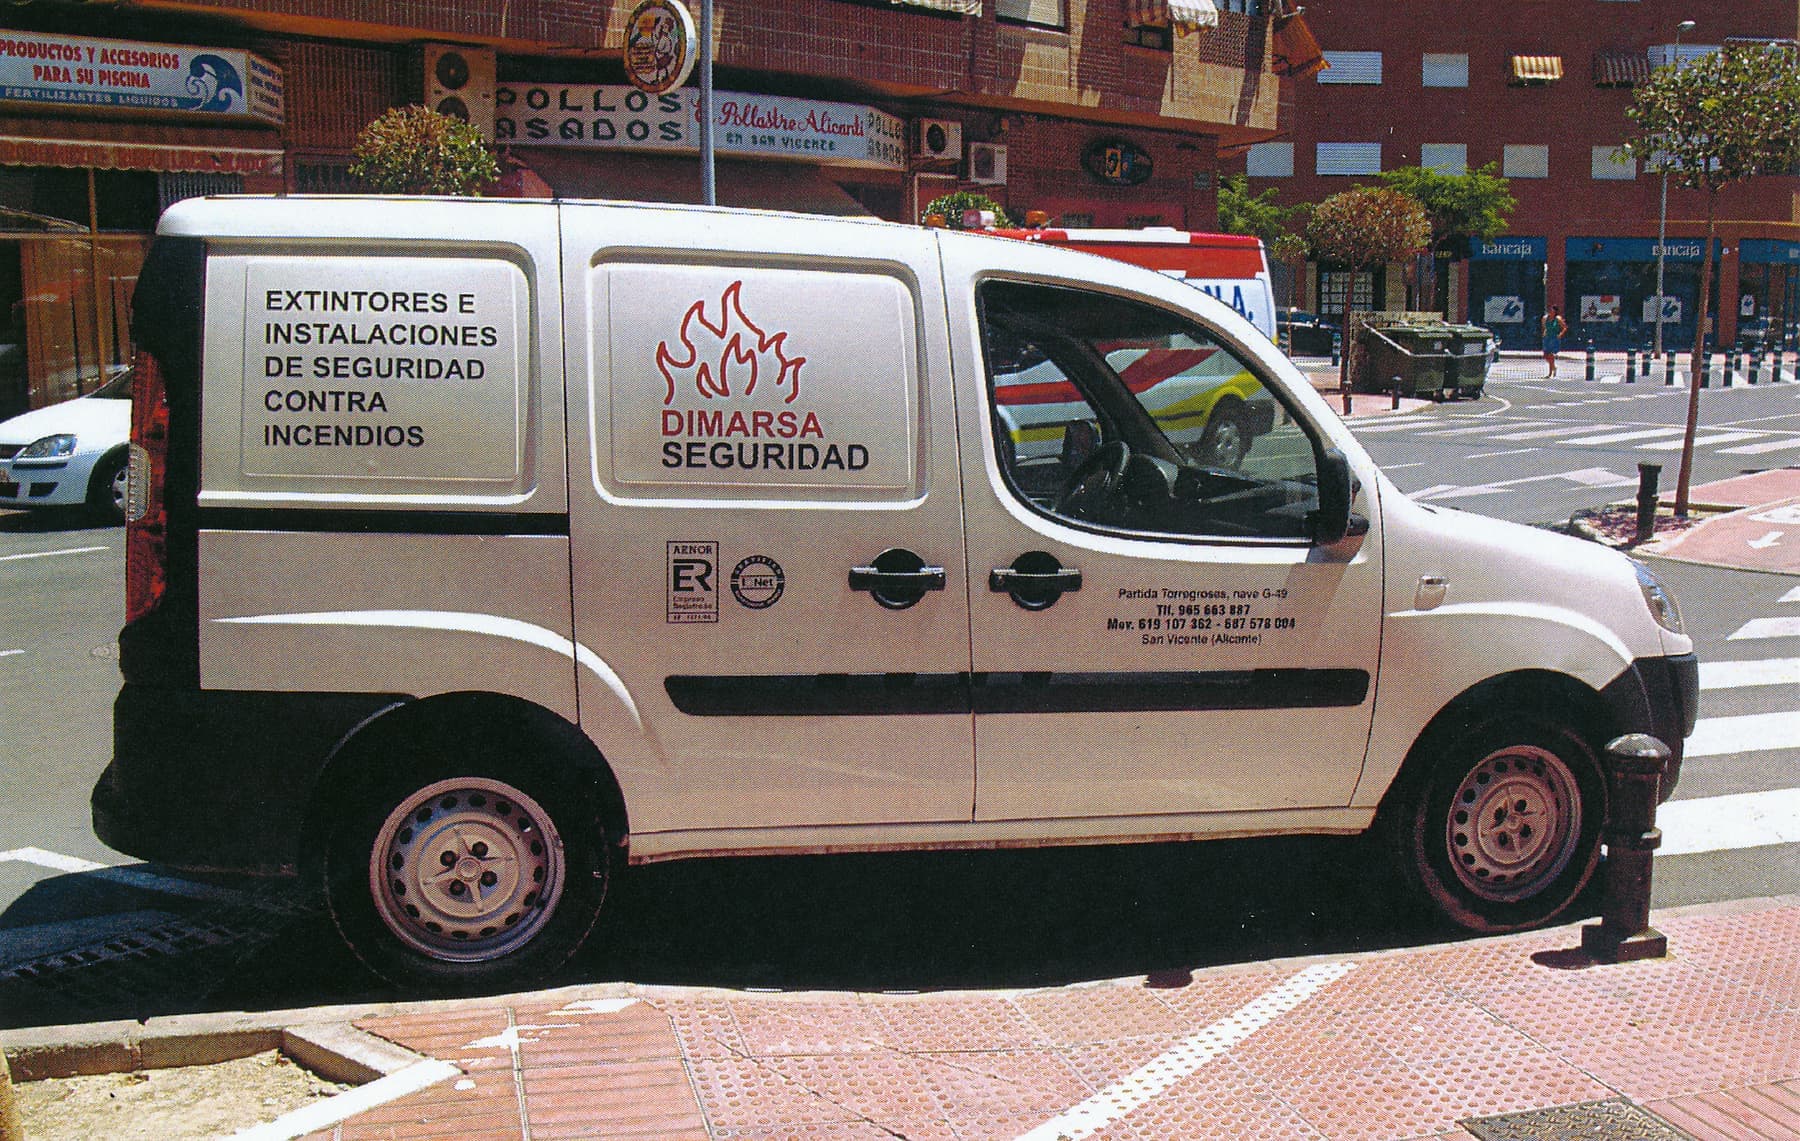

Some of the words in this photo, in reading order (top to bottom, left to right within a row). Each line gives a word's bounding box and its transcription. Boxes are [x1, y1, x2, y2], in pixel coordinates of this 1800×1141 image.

[0, 39, 82, 62] PRODUCTOS
[86, 47, 96, 64] Y
[100, 48, 180, 70] ACCESORIOS
[33, 65, 72, 83] PARA
[76, 67, 94, 85] SU
[99, 70, 150, 89] PISCINA
[5, 87, 112, 103] FERTILIZANTES
[118, 94, 179, 108] LIQUIDOS
[495, 87, 682, 113] POLLOS
[717, 101, 796, 131] Pollastre
[495, 117, 682, 141] ASADOS
[265, 290, 448, 313] EXTINTORES
[458, 293, 476, 314] E
[265, 322, 498, 347] INSTALACIONES
[265, 356, 303, 378] DE
[313, 356, 486, 379] SEGURIDAD
[264, 390, 388, 413] CONTRA
[264, 424, 425, 448] INCENDIOS
[661, 409, 825, 439] DIMARSA
[661, 441, 870, 471] SEGURIDAD
[673, 545, 713, 555] AENOR
[673, 558, 713, 592] ER
[1117, 588, 1158, 600] Partida
[1233, 590, 1259, 600] nave
[1178, 604, 1200, 616] 965
[1204, 604, 1226, 616] 663
[1229, 604, 1251, 616] 887
[1107, 618, 1135, 631] Mov.
[1138, 618, 1161, 630] 619
[1166, 618, 1186, 630] 107
[1190, 618, 1212, 630] 362
[1275, 617, 1296, 629] 004
[1142, 634, 1164, 645] San
[1167, 634, 1208, 645] Vicente
[1211, 633, 1263, 647] (Alicante)
